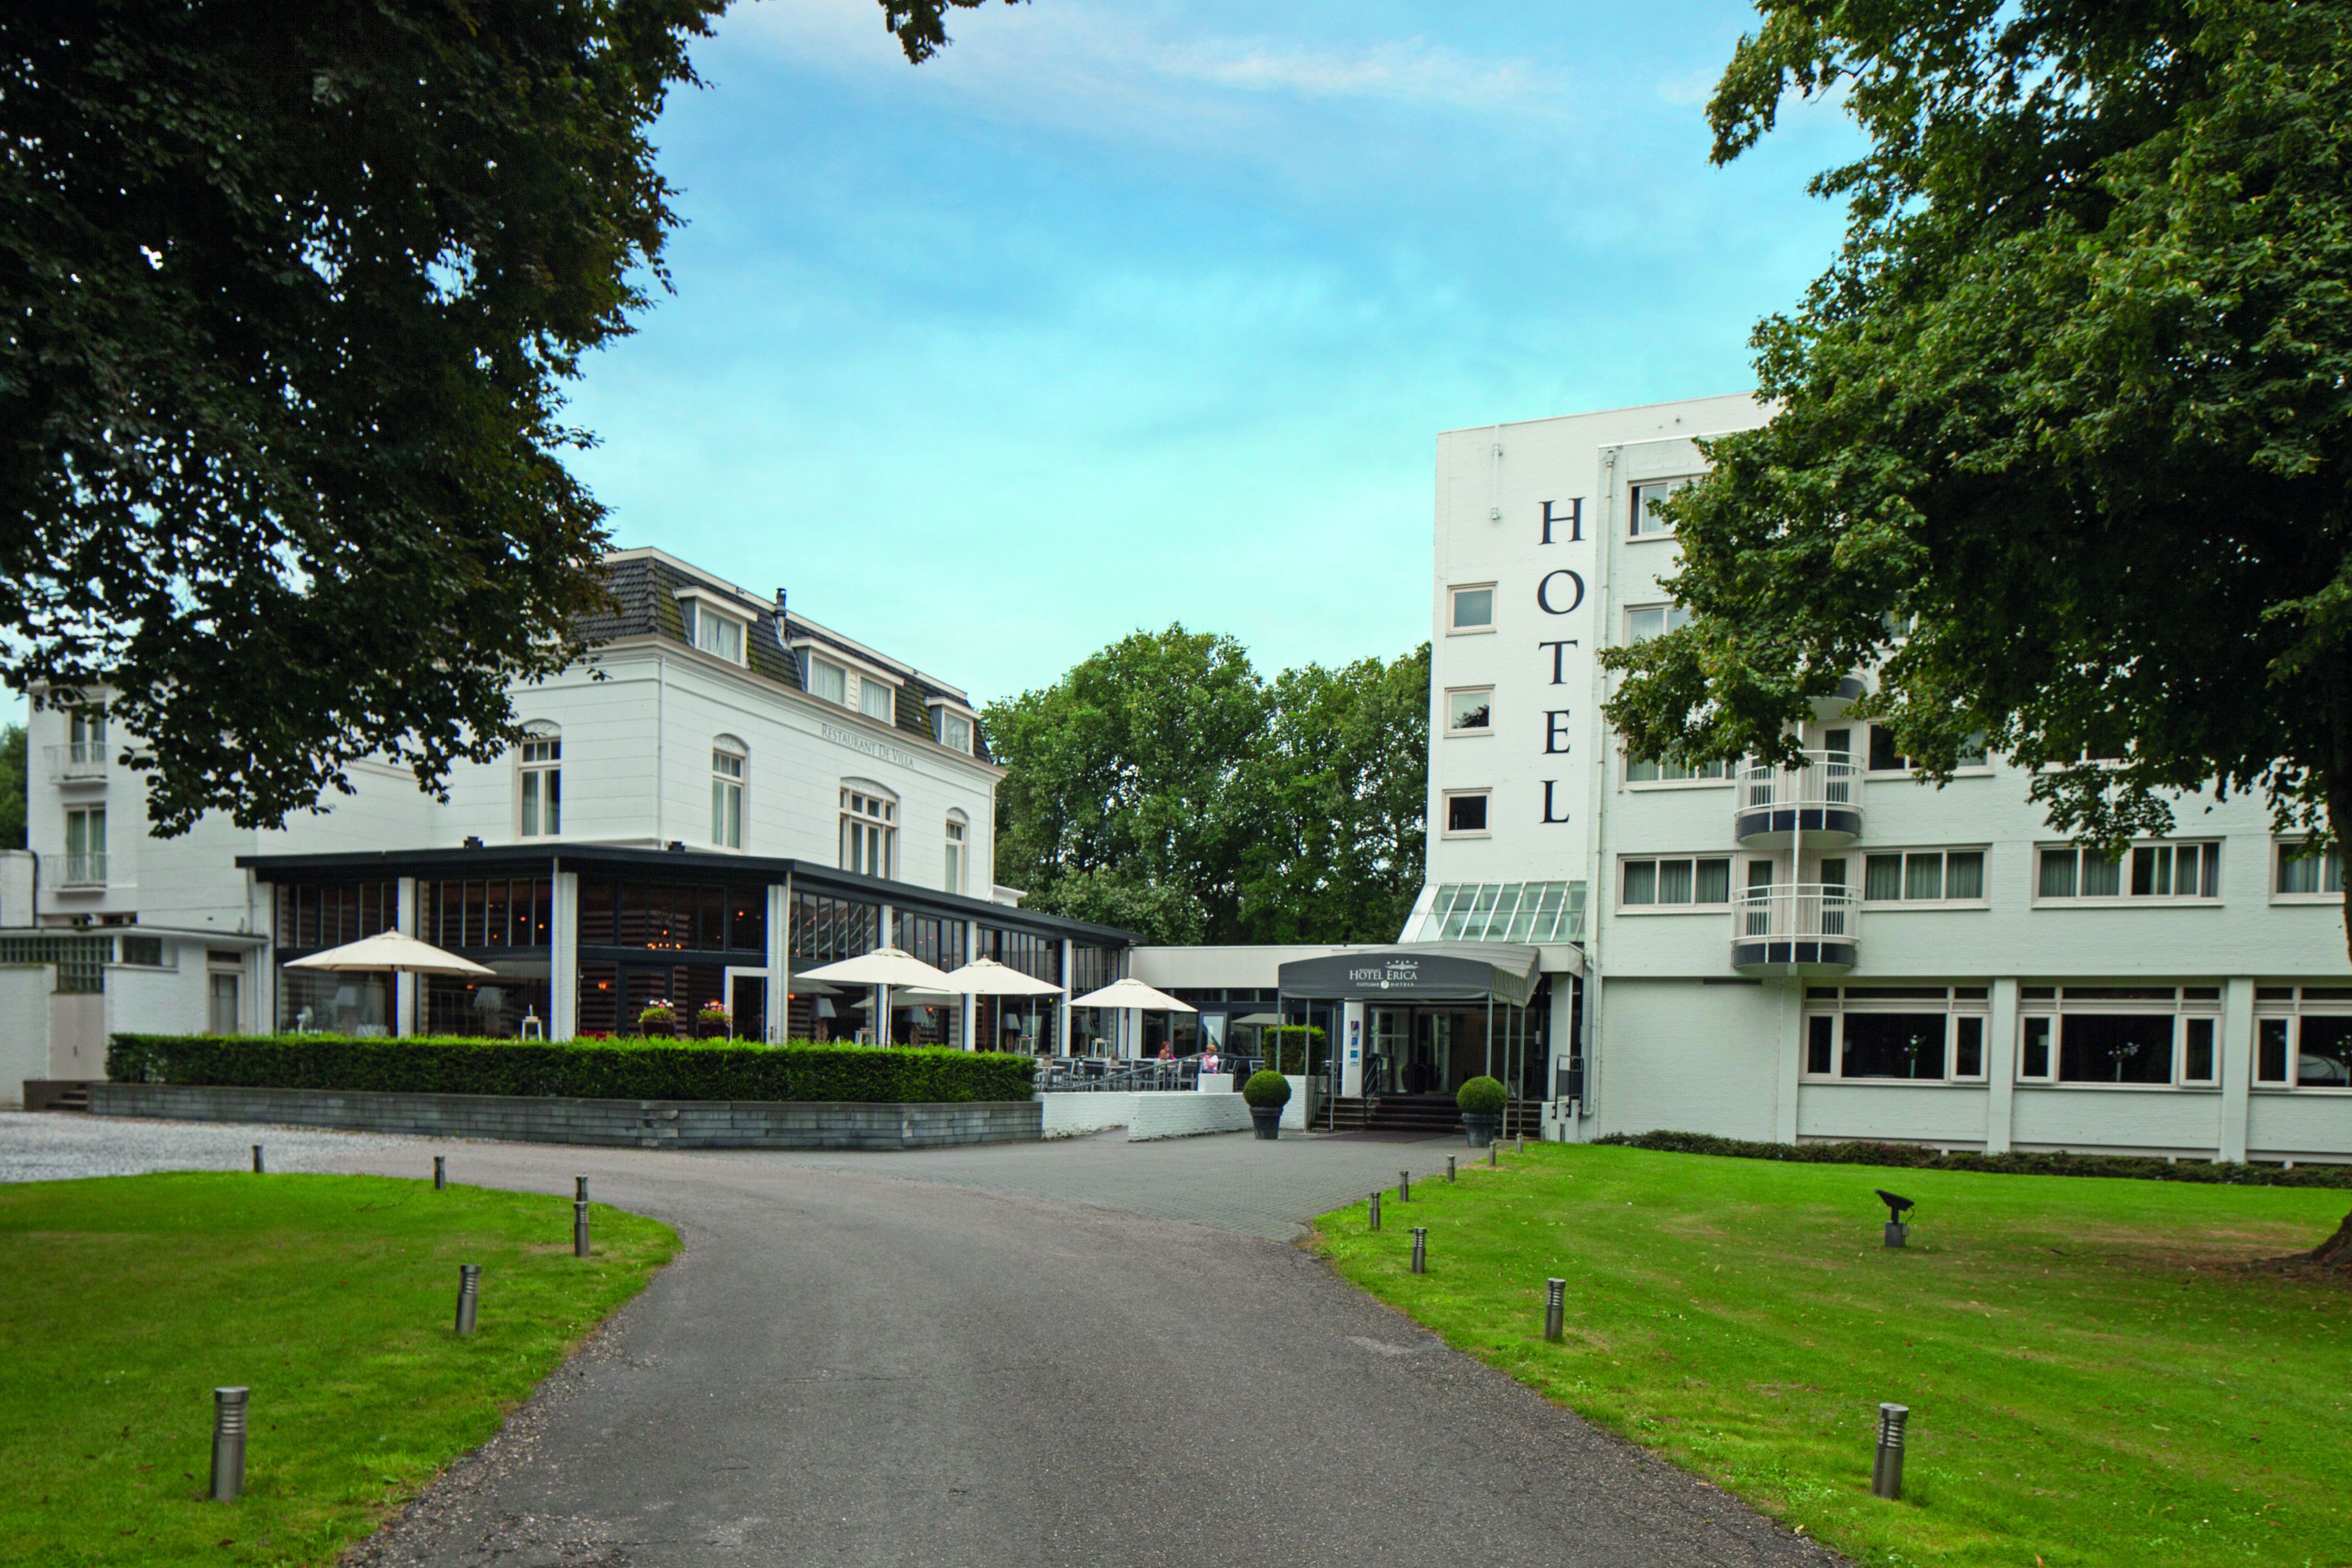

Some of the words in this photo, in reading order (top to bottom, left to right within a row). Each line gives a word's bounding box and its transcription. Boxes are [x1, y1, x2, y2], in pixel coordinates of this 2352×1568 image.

[1537, 497, 1586, 823] HOTEL
[822, 723, 875, 755] RESTAURANT
[879, 744, 890, 758] DE
[892, 748, 914, 768] VILLA
[1349, 970, 1383, 980] HOTEL
[1387, 970, 1417, 980] ERICA
